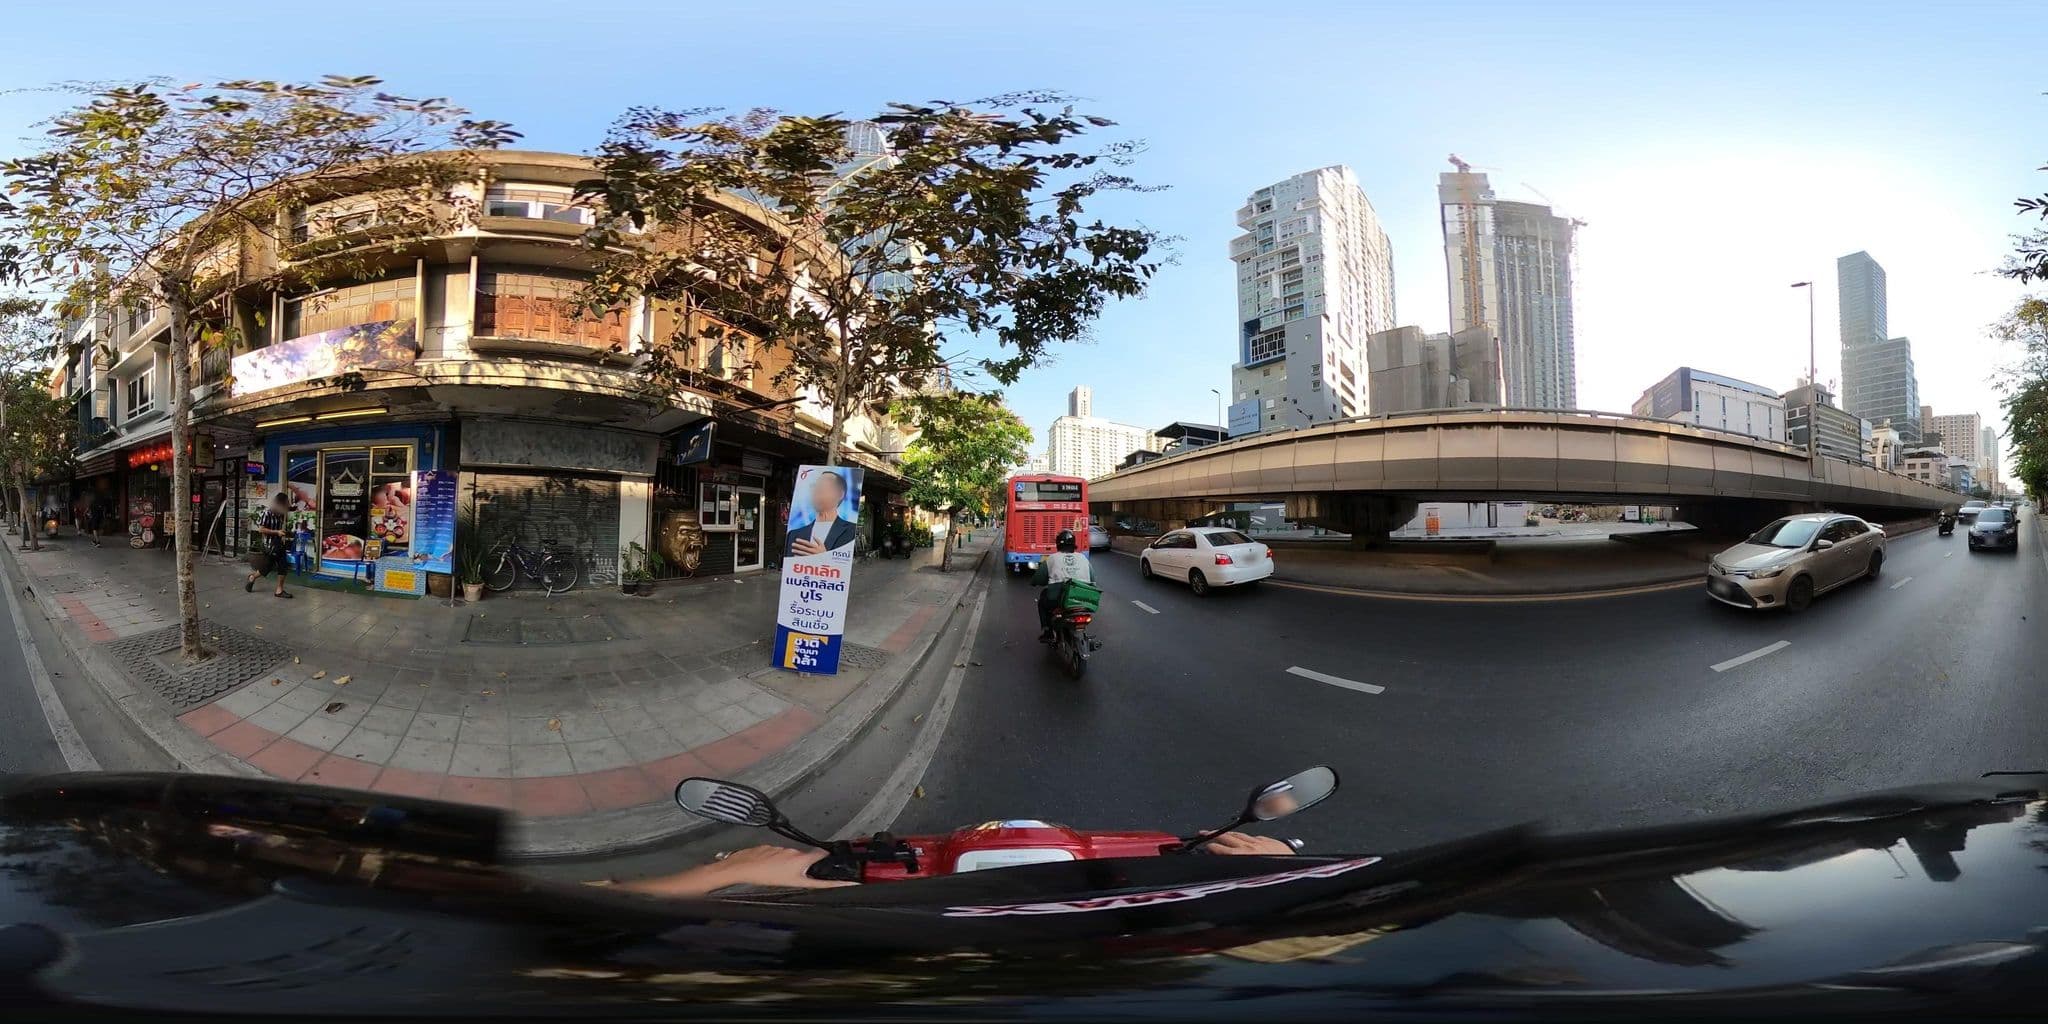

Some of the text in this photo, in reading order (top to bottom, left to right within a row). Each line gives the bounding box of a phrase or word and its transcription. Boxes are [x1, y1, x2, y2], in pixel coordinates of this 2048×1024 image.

[793, 563, 841, 578] ยกเลิก
[786, 576, 845, 591] แบล็กลิสต์
[800, 590, 823, 603] บูโร
[790, 600, 834, 619] รื้อระบบ
[792, 617, 829, 630] สินเชื่อ
[794, 637, 820, 648] ชาติ
[792, 654, 818, 666] กล้า
